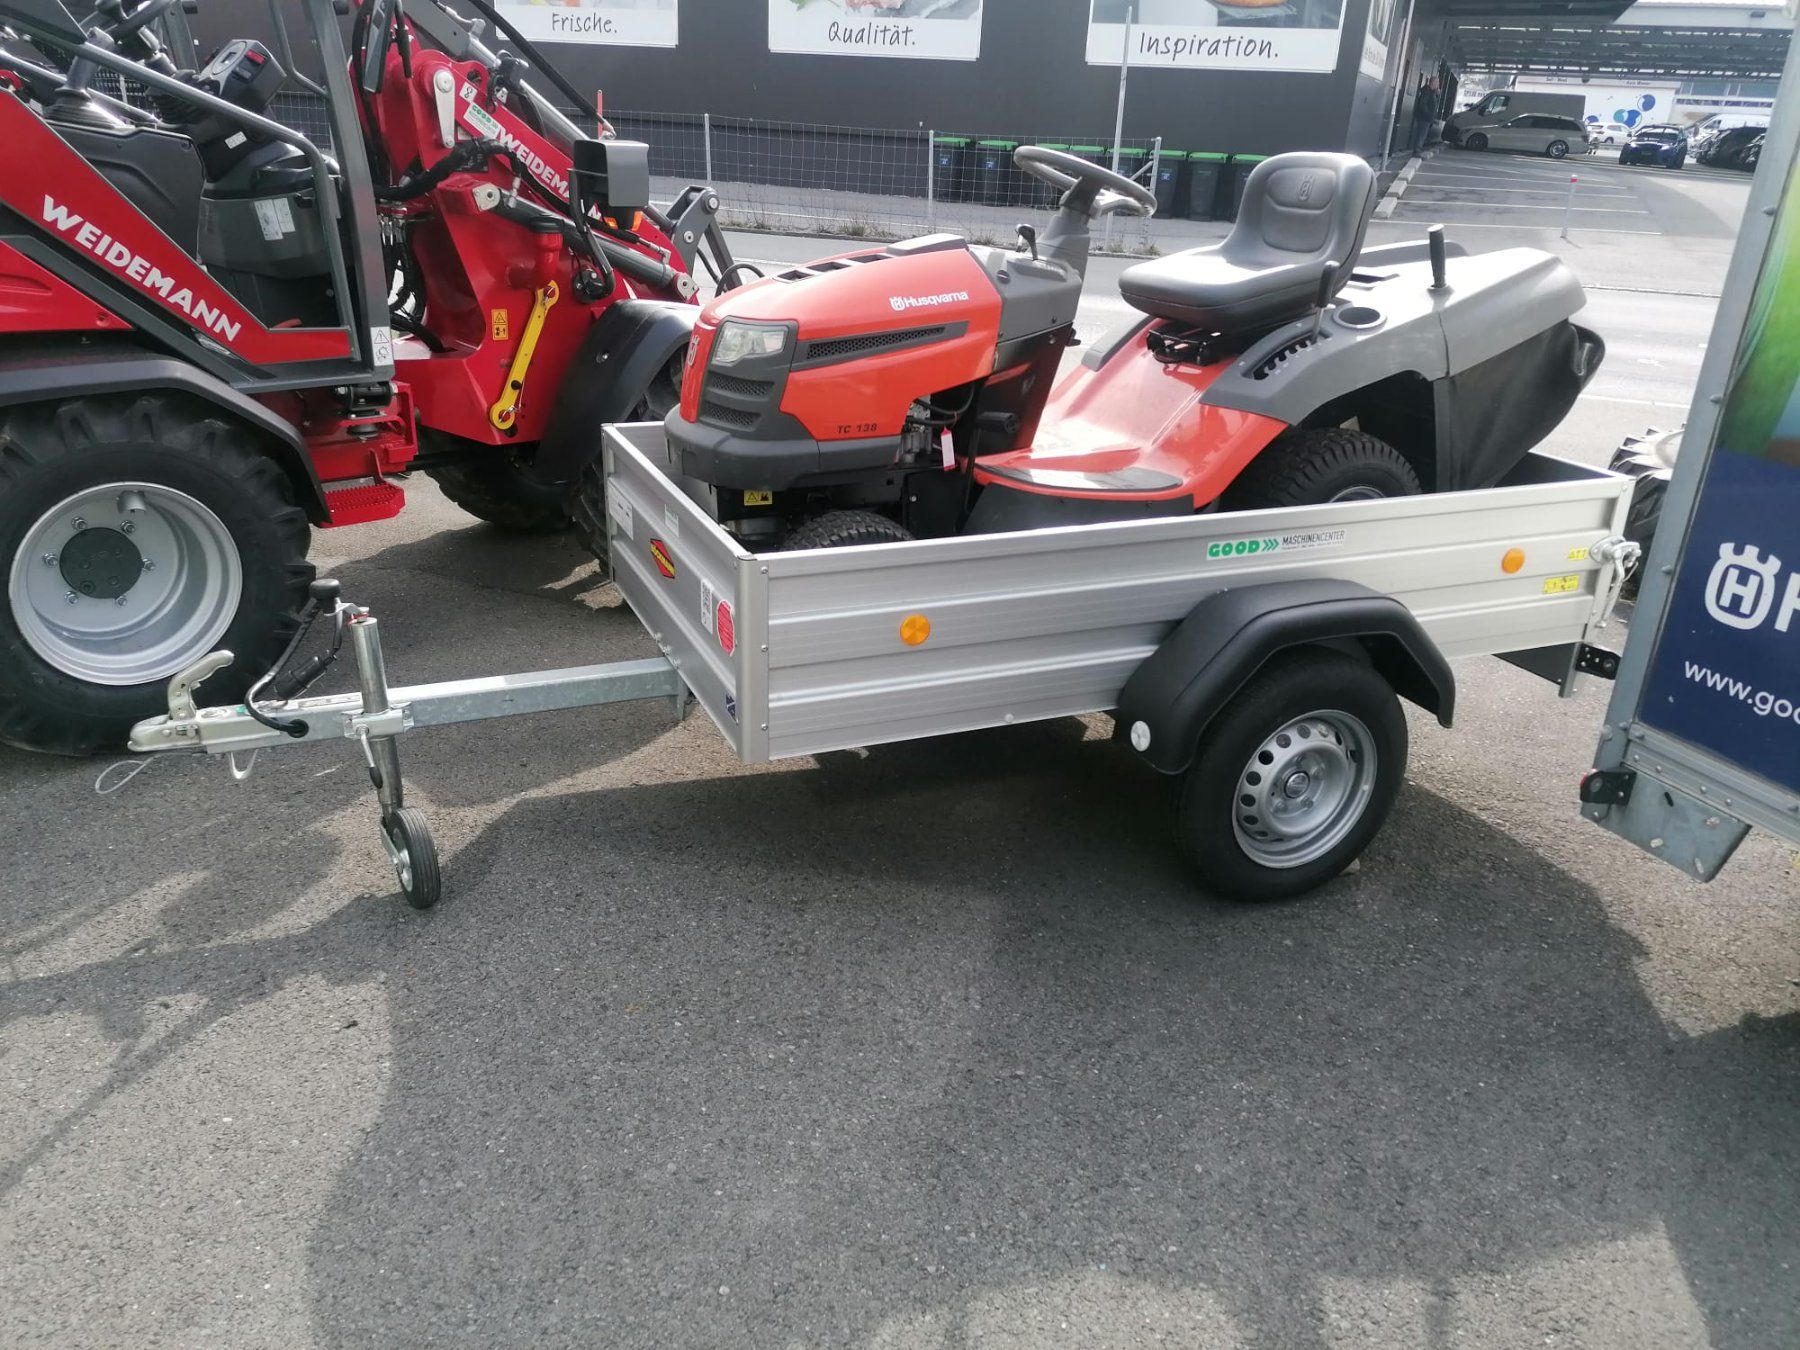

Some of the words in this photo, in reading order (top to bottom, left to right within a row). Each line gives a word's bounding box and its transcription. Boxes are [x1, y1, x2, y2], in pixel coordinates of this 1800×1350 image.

[552, 11, 618, 34] Frische.
[828, 20, 916, 47] Qualität.
[1139, 32, 1279, 61] Inspiration.
[42, 194, 242, 342] WEIDEMANN
[904, 291, 969, 307] Husqvarna
[836, 424, 851, 434] TC
[1208, 540, 1260, 557] GOOD
